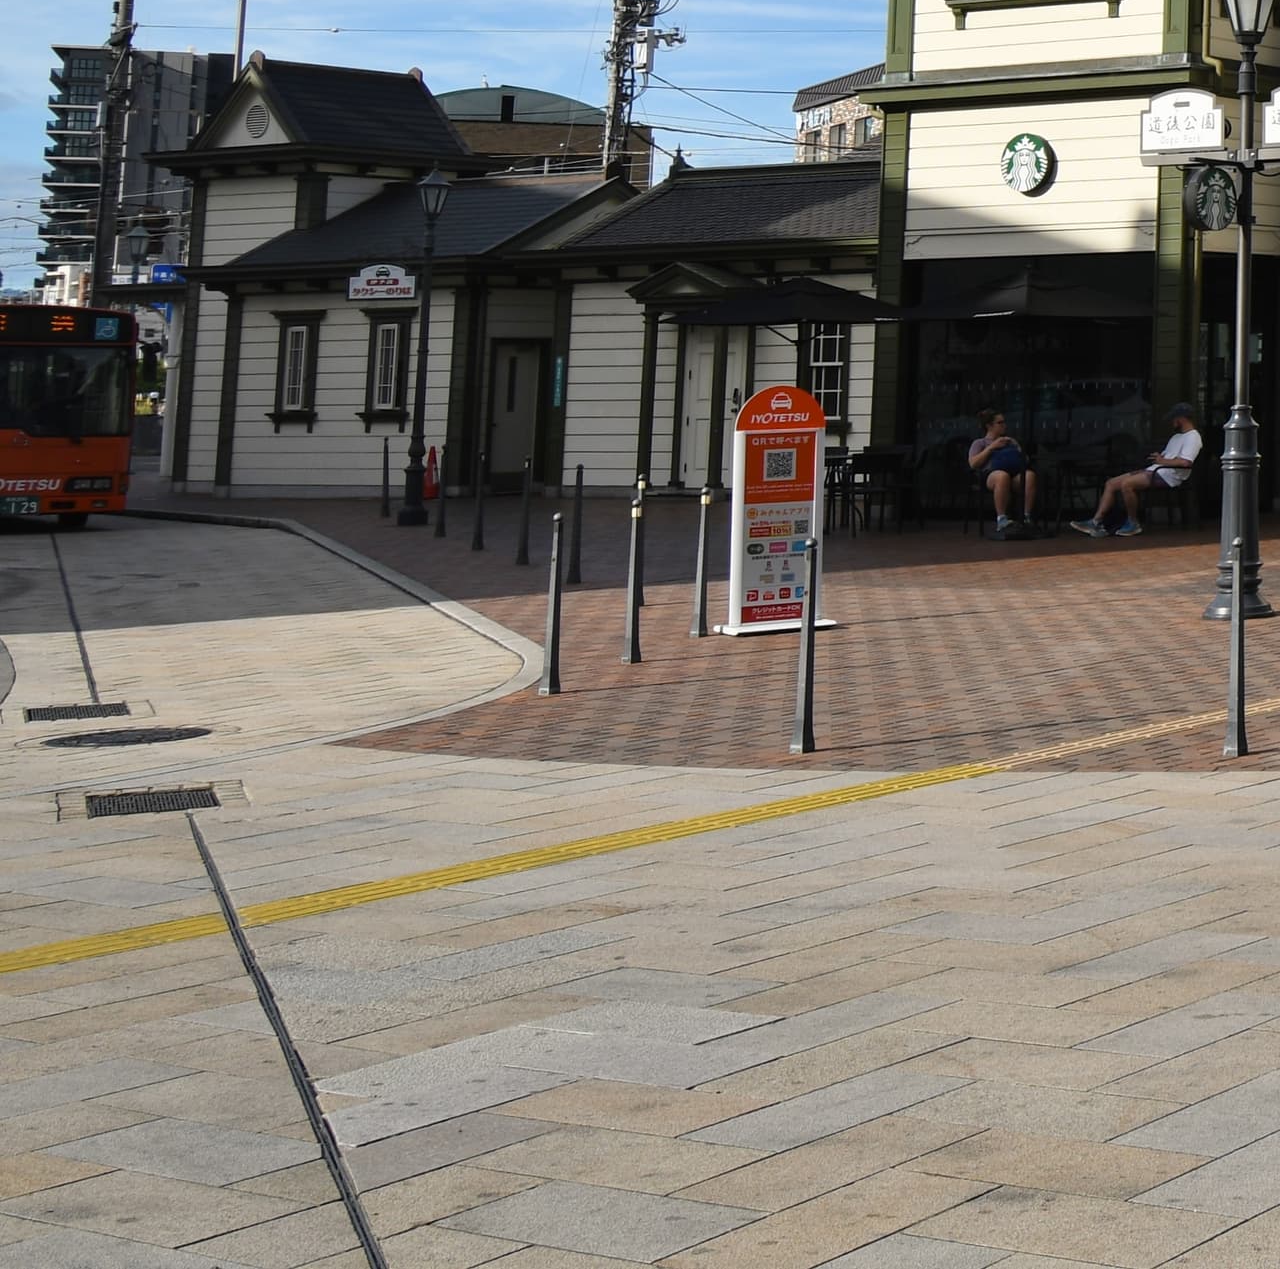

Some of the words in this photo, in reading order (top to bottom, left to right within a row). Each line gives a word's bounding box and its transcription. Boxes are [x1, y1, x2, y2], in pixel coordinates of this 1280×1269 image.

[351, 287, 412, 297] タクシーのりば
[751, 412, 810, 424] IYOTETSU
